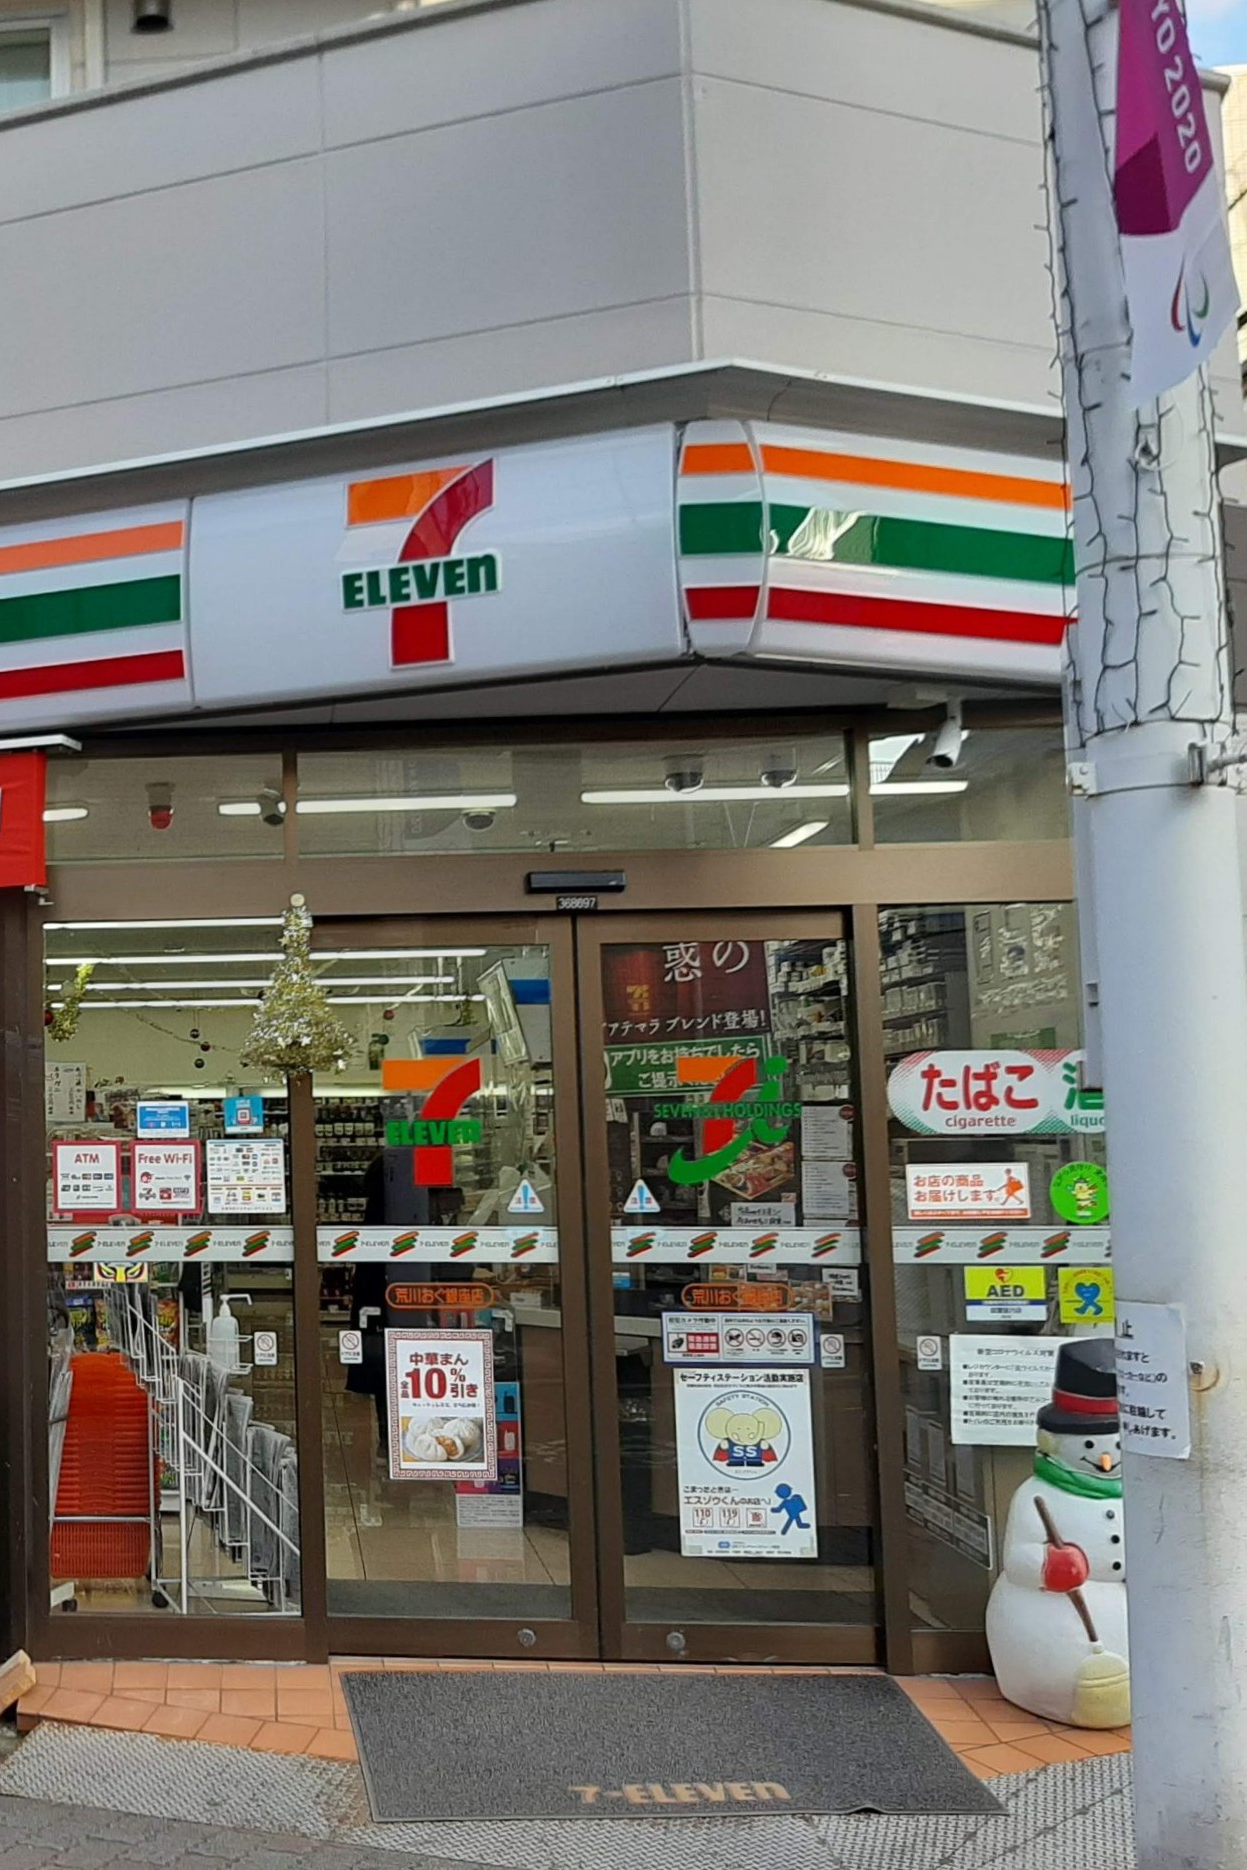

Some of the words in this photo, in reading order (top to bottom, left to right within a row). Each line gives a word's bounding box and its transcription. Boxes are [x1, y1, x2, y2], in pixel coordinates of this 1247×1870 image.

[1164, 56, 1202, 174] 2020
[602, 1020, 661, 1037] アテマラ
[921, 1061, 1039, 1111] たばこ
[722, 1103, 803, 1119] HOLDINGS
[945, 1115, 1016, 1129] cigarette
[1070, 1114, 1105, 1127] liquo
[74, 1153, 100, 1164] ATM
[138, 1153, 161, 1164] Free
[164, 1153, 192, 1164] Wi-Fi
[914, 1174, 984, 1188] お店の商品
[986, 1285, 1026, 1298] AED
[410, 1352, 469, 1366] 中華まん
[405, 1368, 447, 1399] 10
[733, 1446, 757, 1457] SS
[695, 1508, 711, 1518] 110
[722, 1508, 738, 1518] 119
